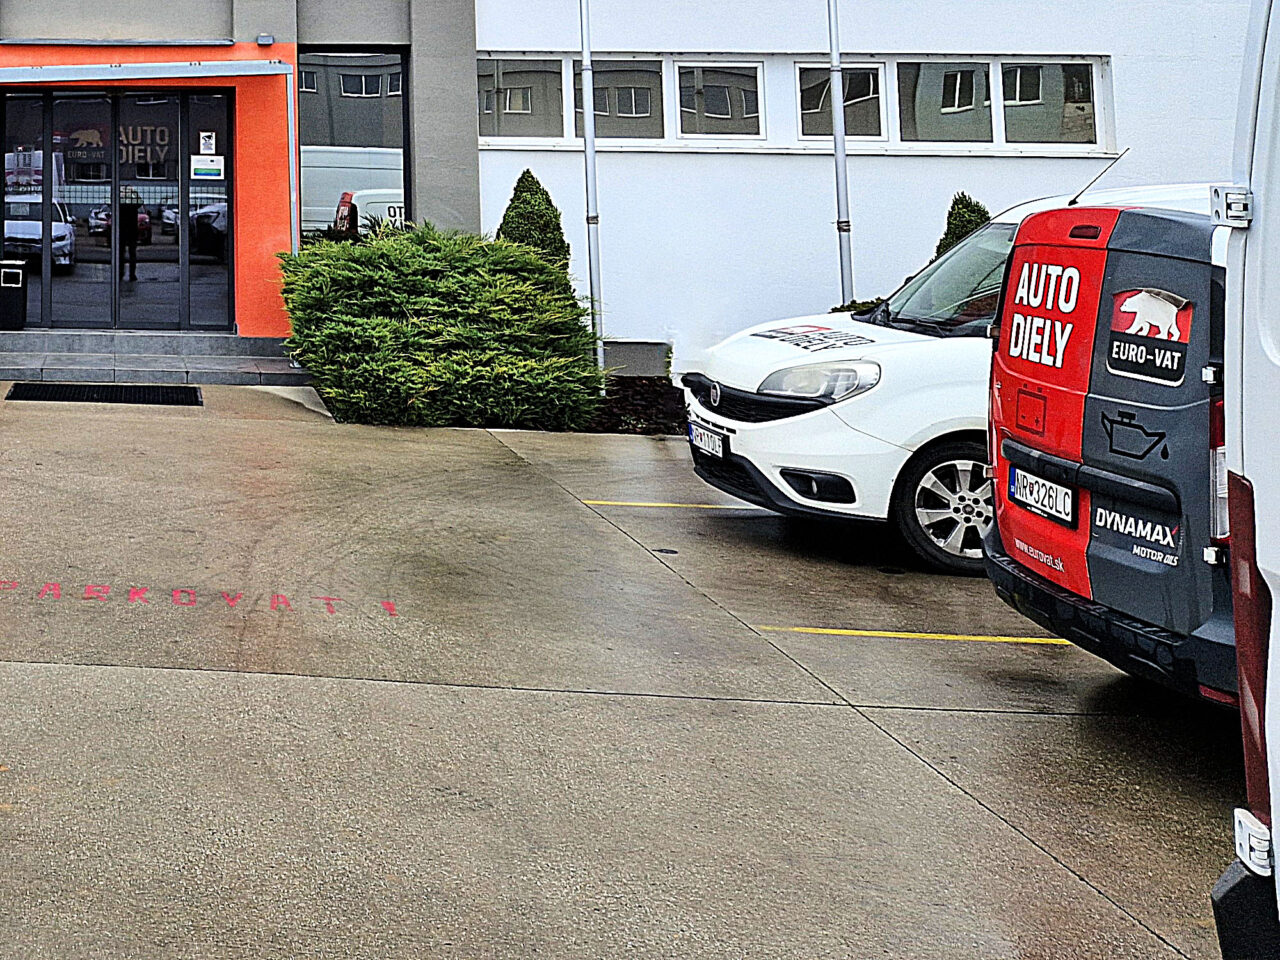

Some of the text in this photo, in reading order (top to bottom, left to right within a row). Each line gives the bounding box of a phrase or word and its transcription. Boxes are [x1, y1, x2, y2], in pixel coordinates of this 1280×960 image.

[1014, 262, 1081, 314] AUTO
[1008, 311, 1074, 369] DIELY
[1111, 341, 1182, 370] EURO-VAT
[1095, 507, 1175, 548] DYNAMAX
[1132, 544, 1179, 567] MOTOR OILS
